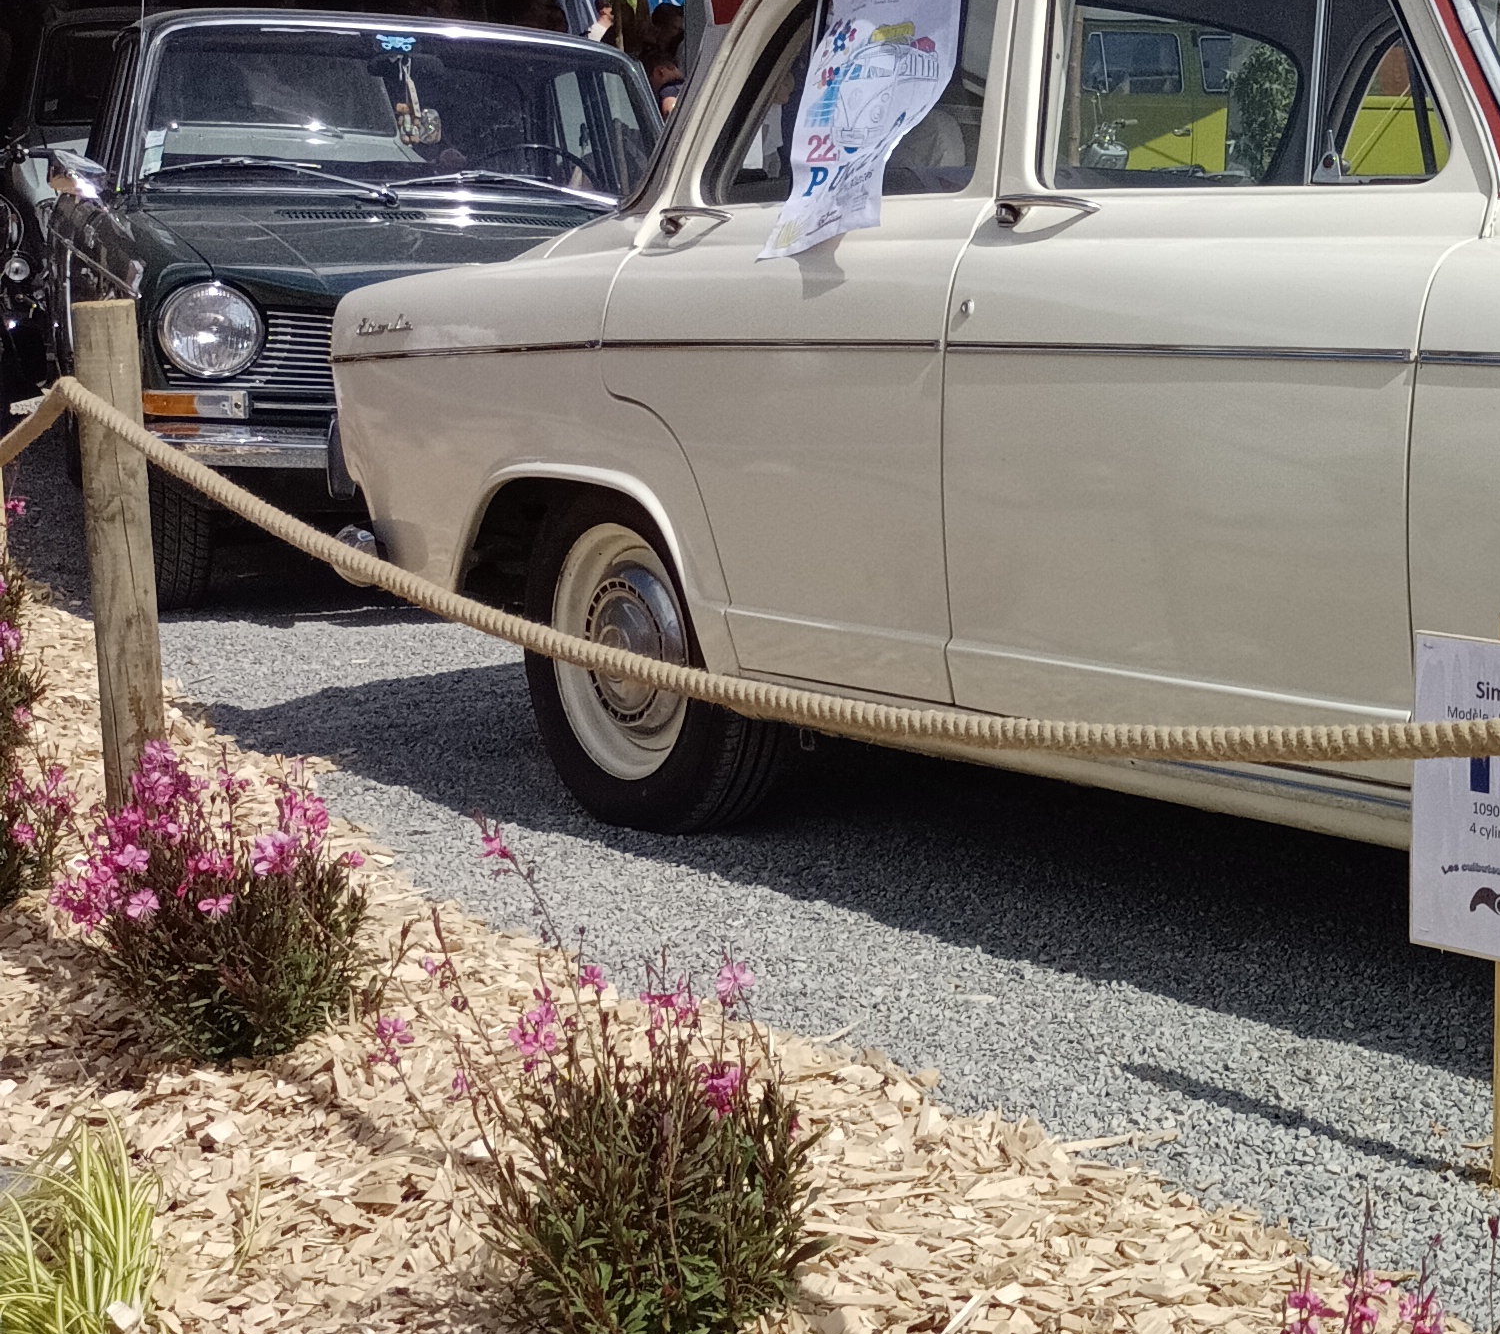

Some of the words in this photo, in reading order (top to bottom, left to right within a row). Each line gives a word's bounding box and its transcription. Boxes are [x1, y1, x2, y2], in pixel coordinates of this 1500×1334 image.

[1447, 705, 1489, 721] Modèle
[1472, 802, 1500, 818] 1090
[1469, 822, 1476, 835] 4
[1441, 863, 1460, 875] Les
